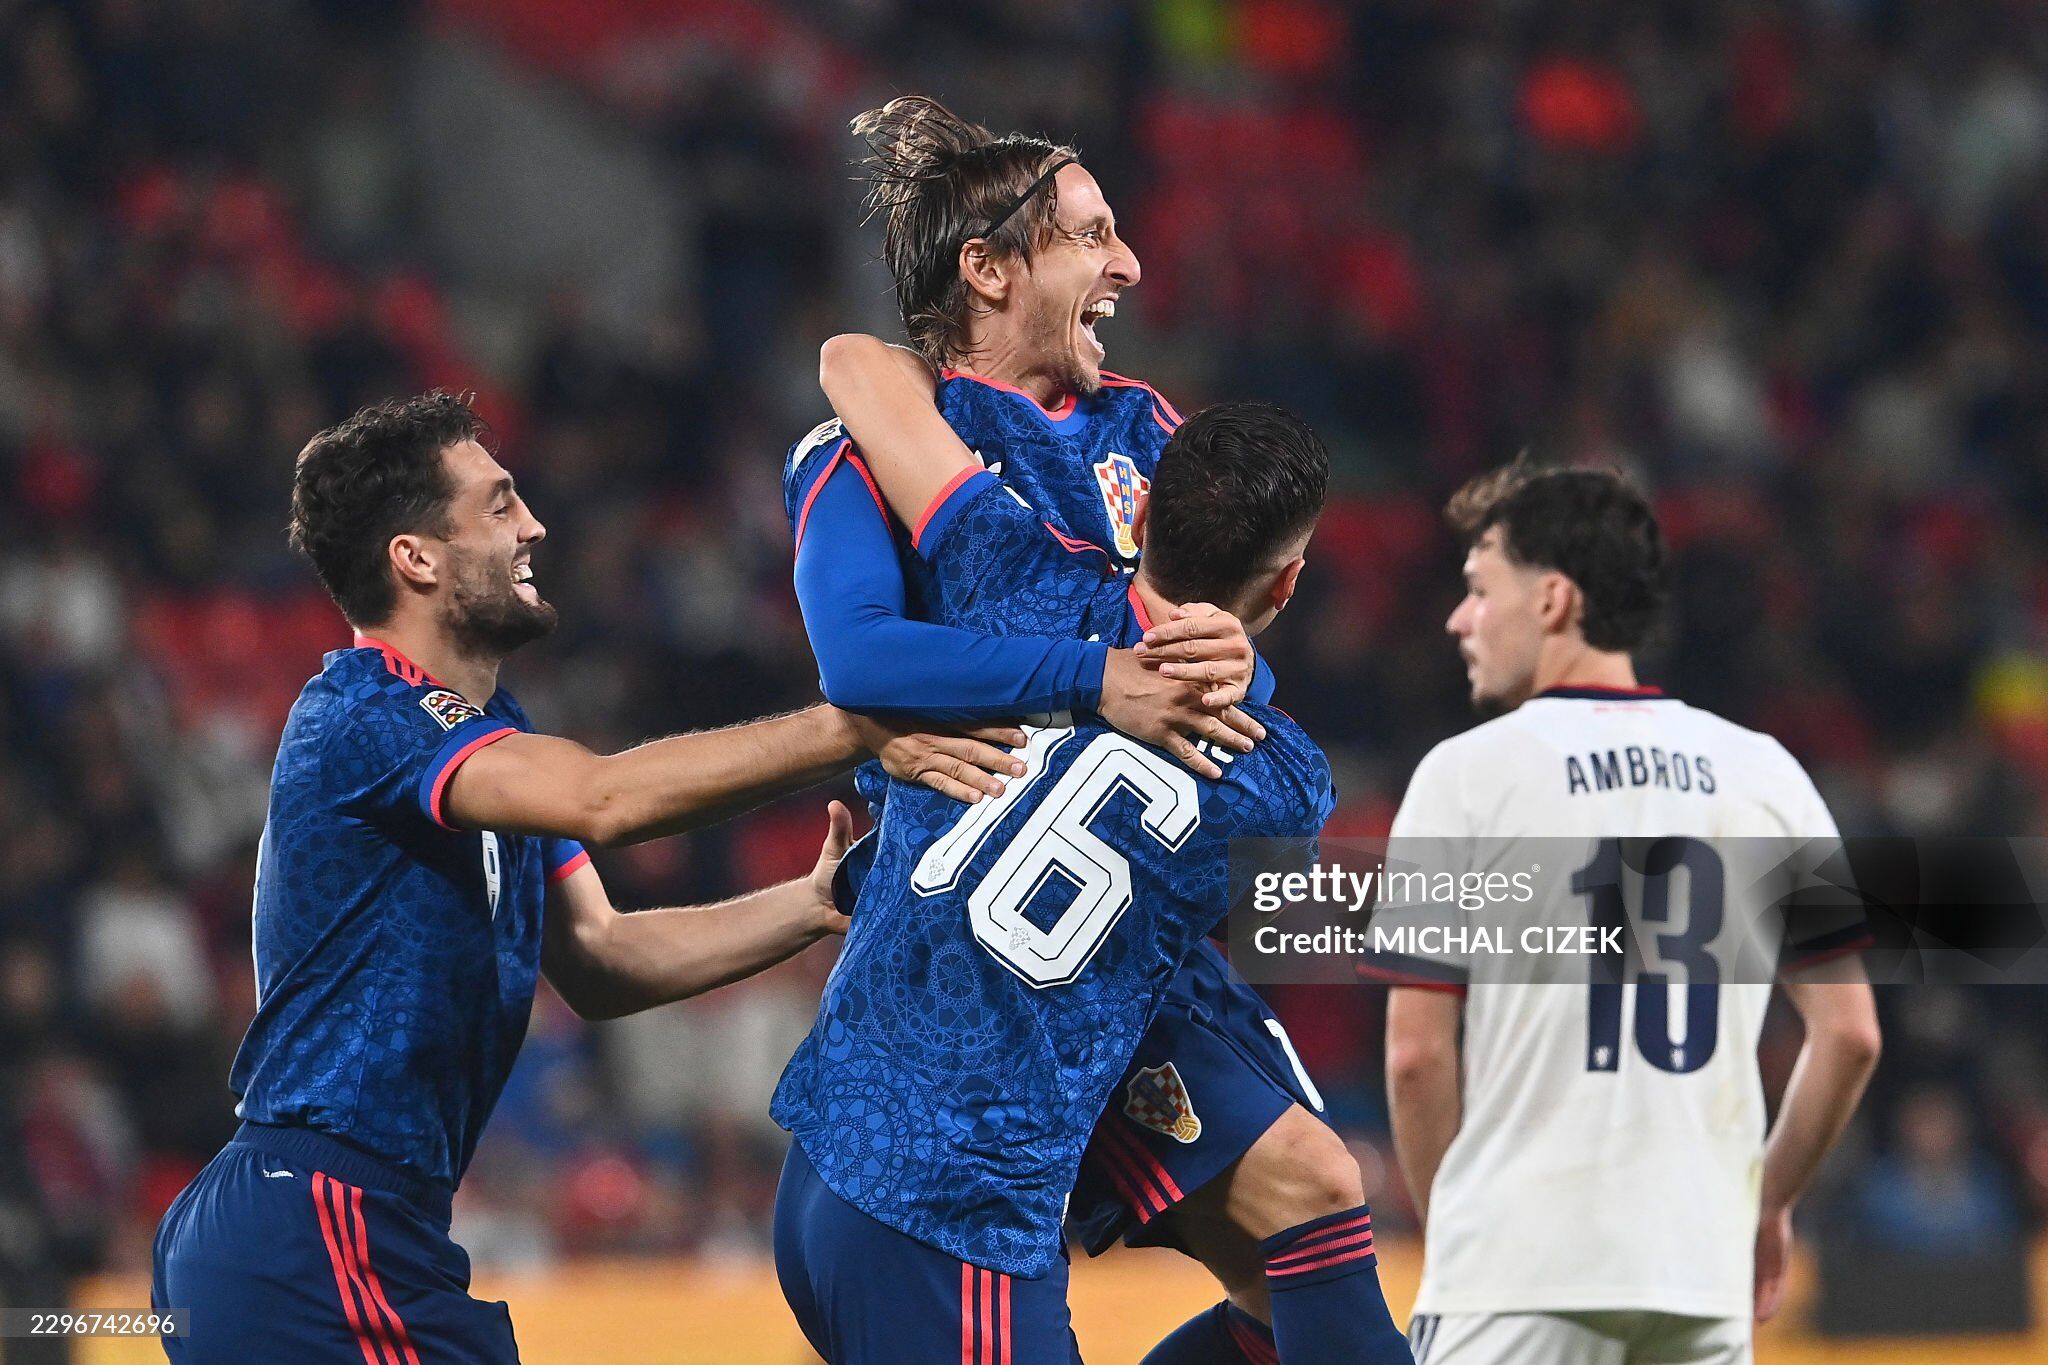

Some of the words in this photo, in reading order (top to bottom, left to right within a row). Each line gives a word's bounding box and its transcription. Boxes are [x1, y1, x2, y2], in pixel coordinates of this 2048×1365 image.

[1118, 466, 1132, 514] HNS
[1567, 746, 1716, 795] AMBROS
[911, 710, 1200, 989] 16
[1571, 836, 1724, 1073] 13
